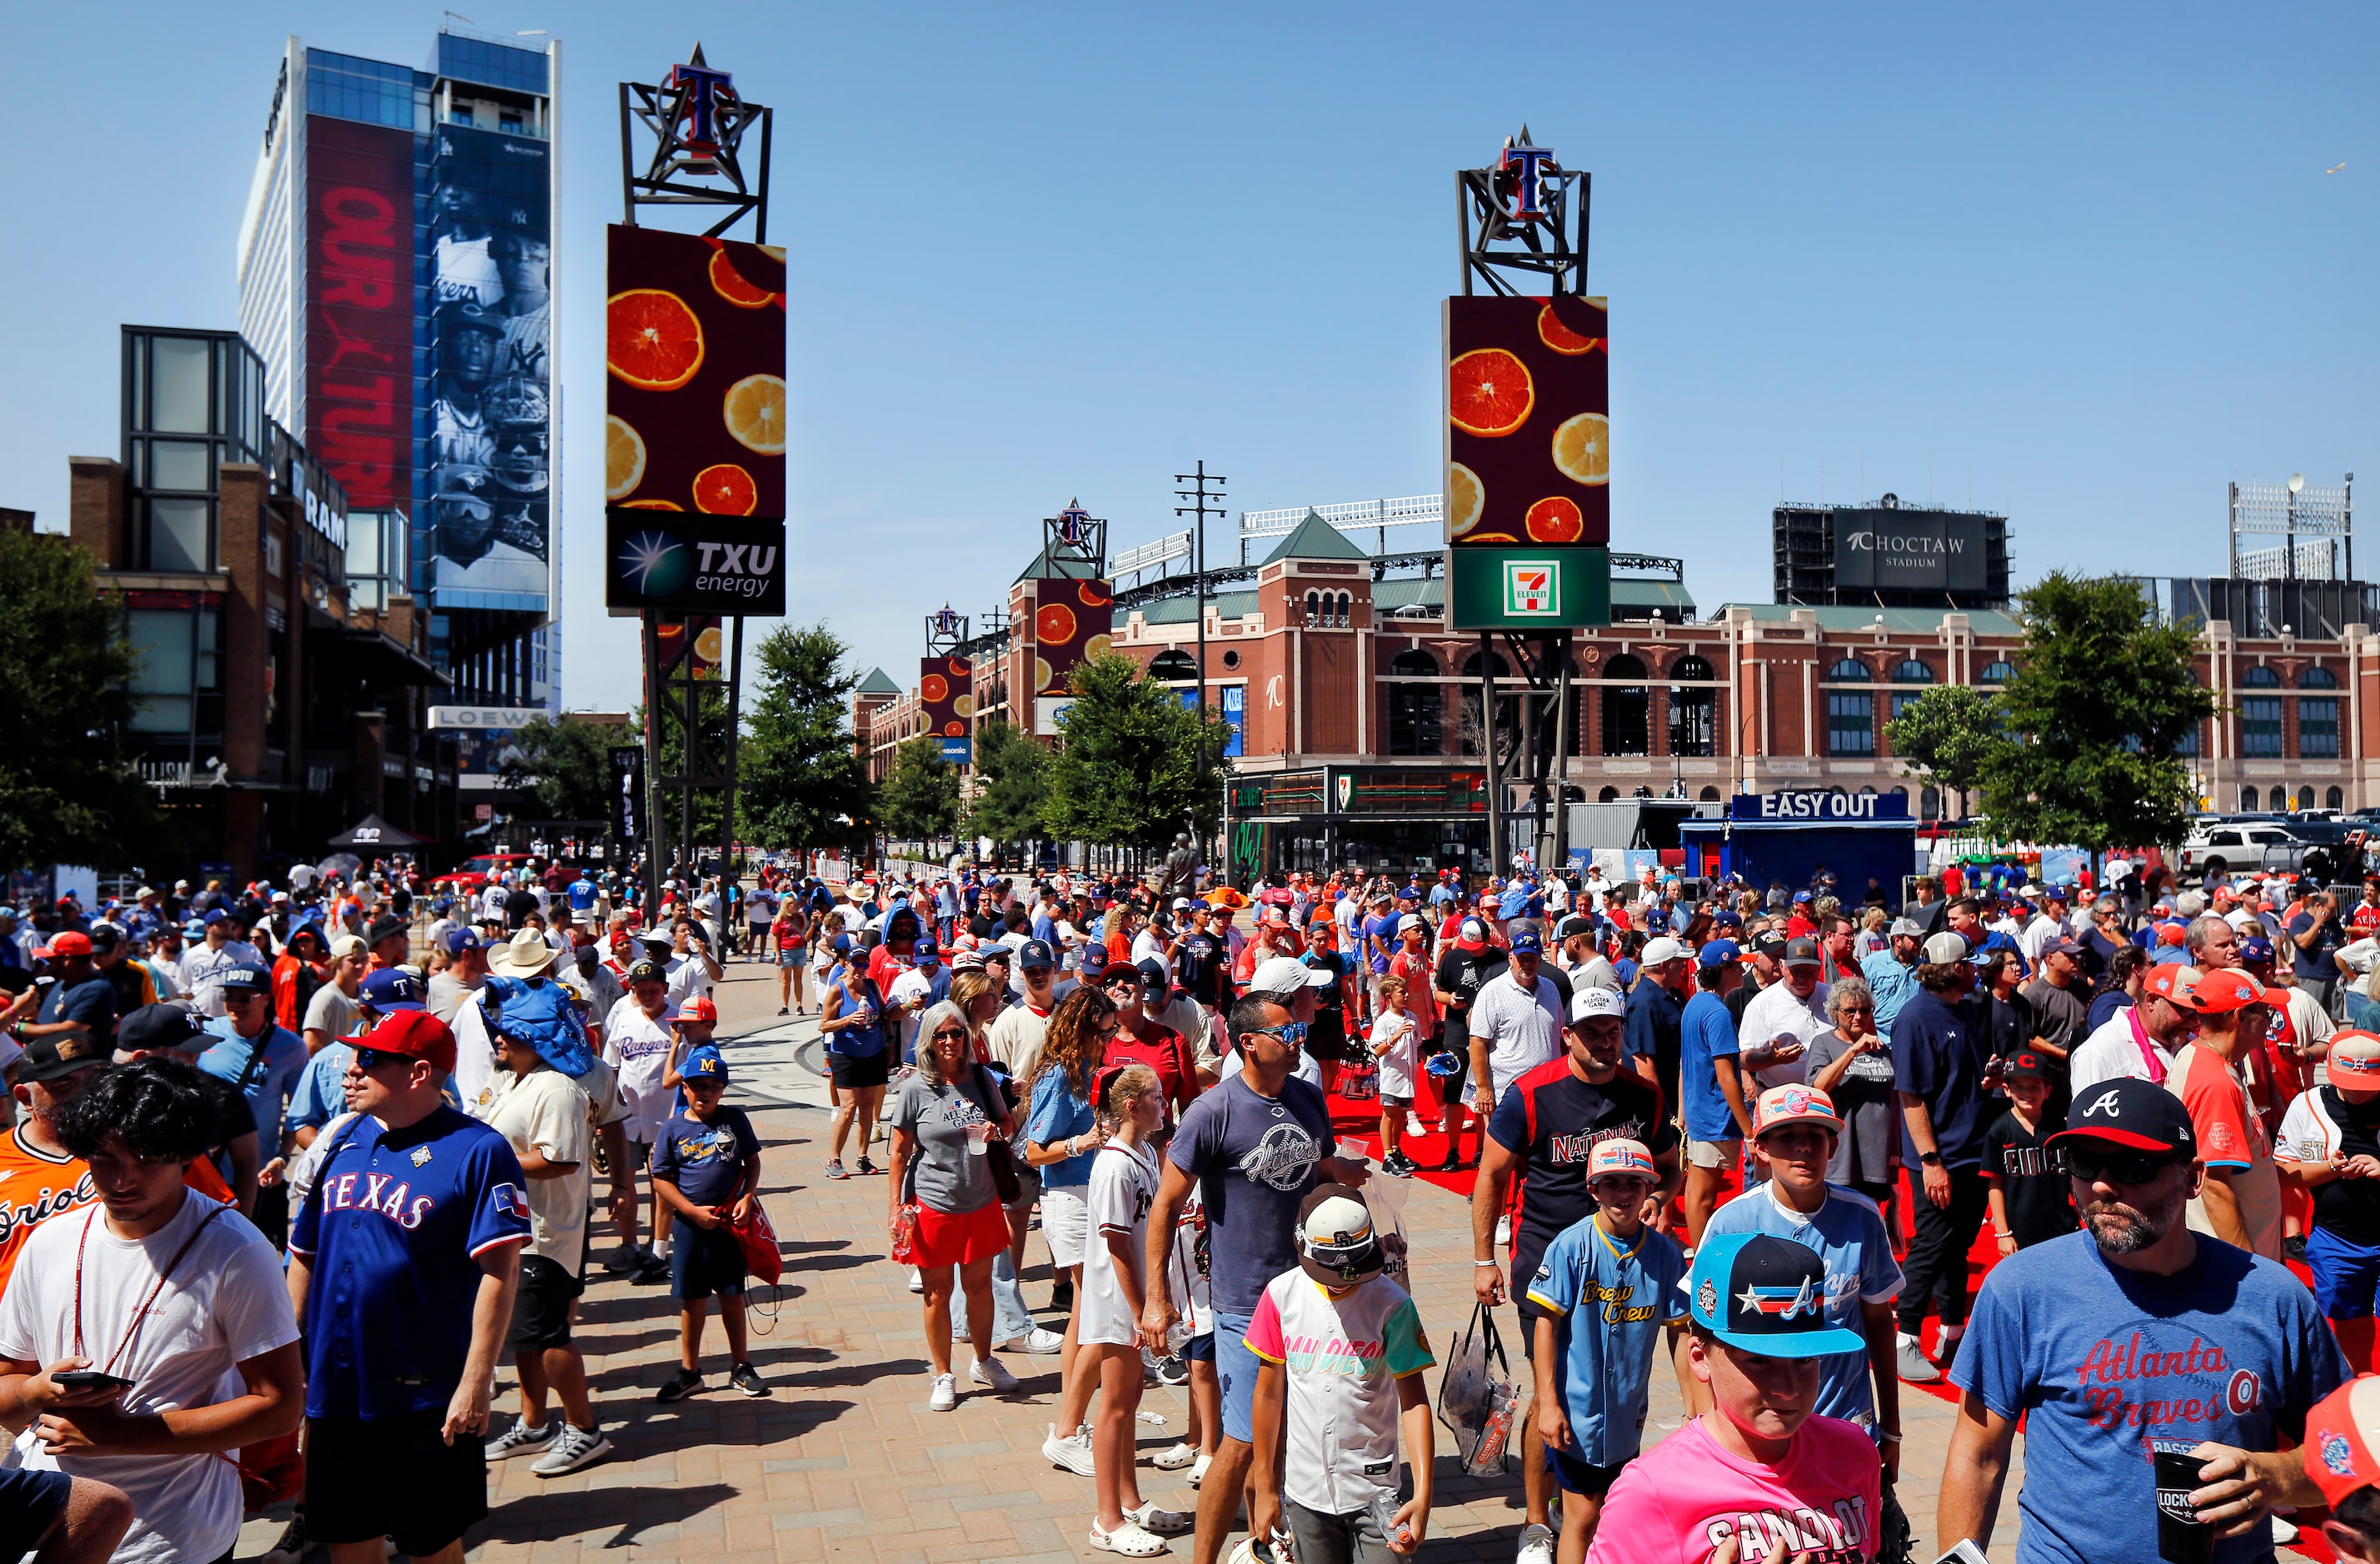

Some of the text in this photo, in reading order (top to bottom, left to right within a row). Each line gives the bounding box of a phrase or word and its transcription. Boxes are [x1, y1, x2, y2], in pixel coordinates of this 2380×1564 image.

[321, 186, 397, 310] OUR
[321, 376, 393, 508] TUR
[305, 488, 346, 551] RAM
[1858, 530, 1963, 554] CHOCTAW
[696, 542, 776, 575] TXU
[1885, 557, 1935, 568] STADIUM
[696, 576, 769, 597] energy
[943, 745, 967, 755] sonic
[622, 774, 635, 836] RAM
[1761, 794, 1879, 817] EASY OUT
[700, 1058, 717, 1073] M
[2018, 1054, 2035, 1068] C
[1261, 1123, 1310, 1144] TRAINING ACADEMY
[1240, 1138, 1322, 1181] Hitters
[322, 1172, 435, 1231] TEXAS
[1580, 1280, 1635, 1305] Brew
[1602, 1302, 1657, 1325] Crew
[2075, 1332, 2230, 1384] Atlanta
[2084, 1386, 2227, 1429] Braves
[1477, 1431, 1501, 1463] GATORADE
[2159, 1492, 2194, 1508] LOCK
[1706, 1494, 1869, 1562] SANDLOT
